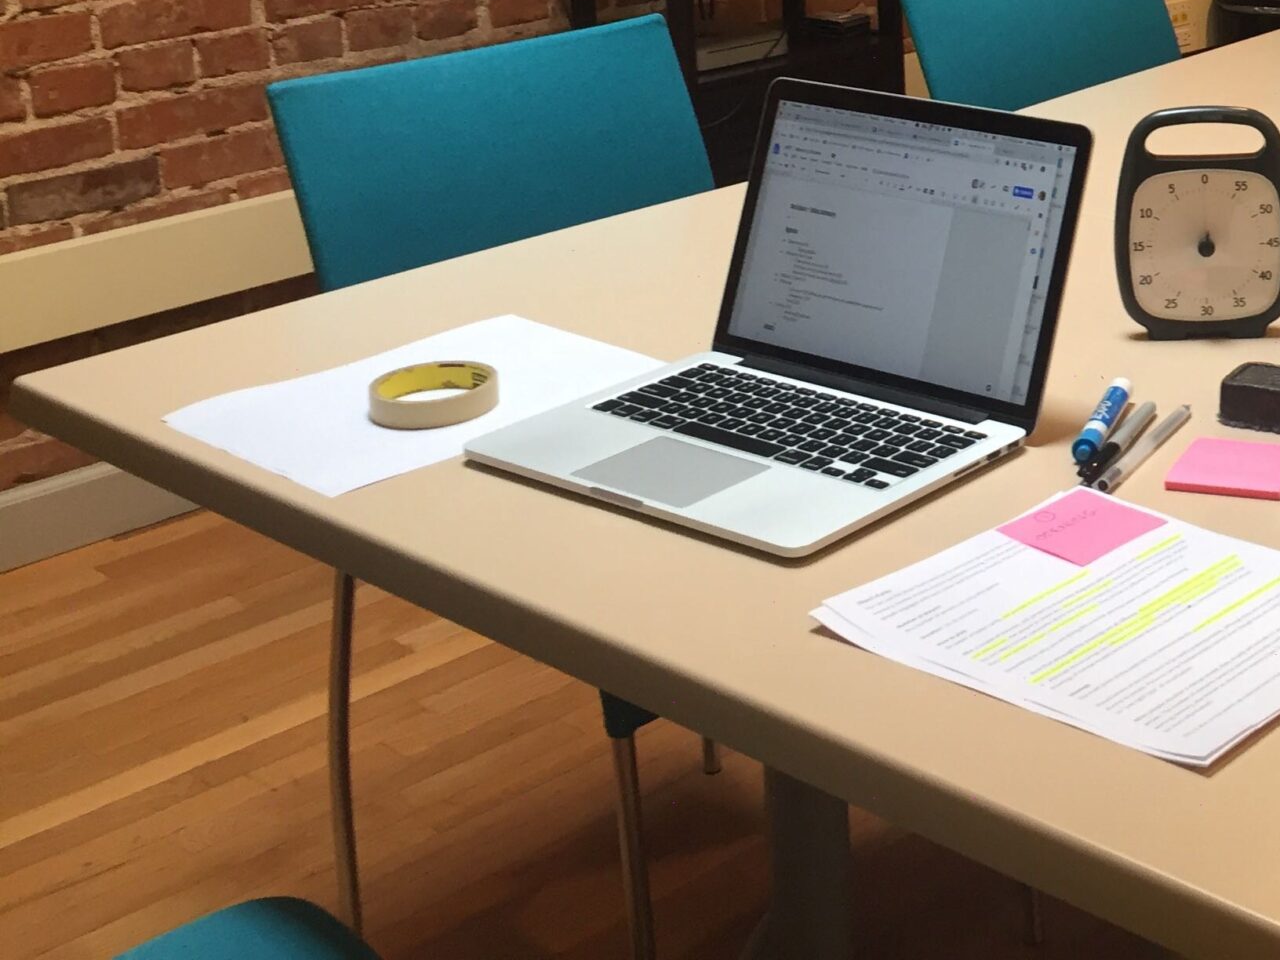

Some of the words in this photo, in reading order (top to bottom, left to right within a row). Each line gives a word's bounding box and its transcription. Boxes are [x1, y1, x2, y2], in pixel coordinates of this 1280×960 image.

[1201, 174, 1209, 184] 0
[1168, 184, 1175, 194] 5
[1235, 181, 1248, 191] 55
[1140, 208, 1153, 218] 10
[1259, 204, 1273, 214] 50
[1133, 241, 1145, 252] 15
[1266, 237, 1280, 247] 45
[1139, 275, 1153, 285] 20
[1258, 270, 1273, 280] 40
[1164, 298, 1178, 309] 25
[1233, 297, 1246, 307] 35
[1201, 306, 1214, 316] 30
